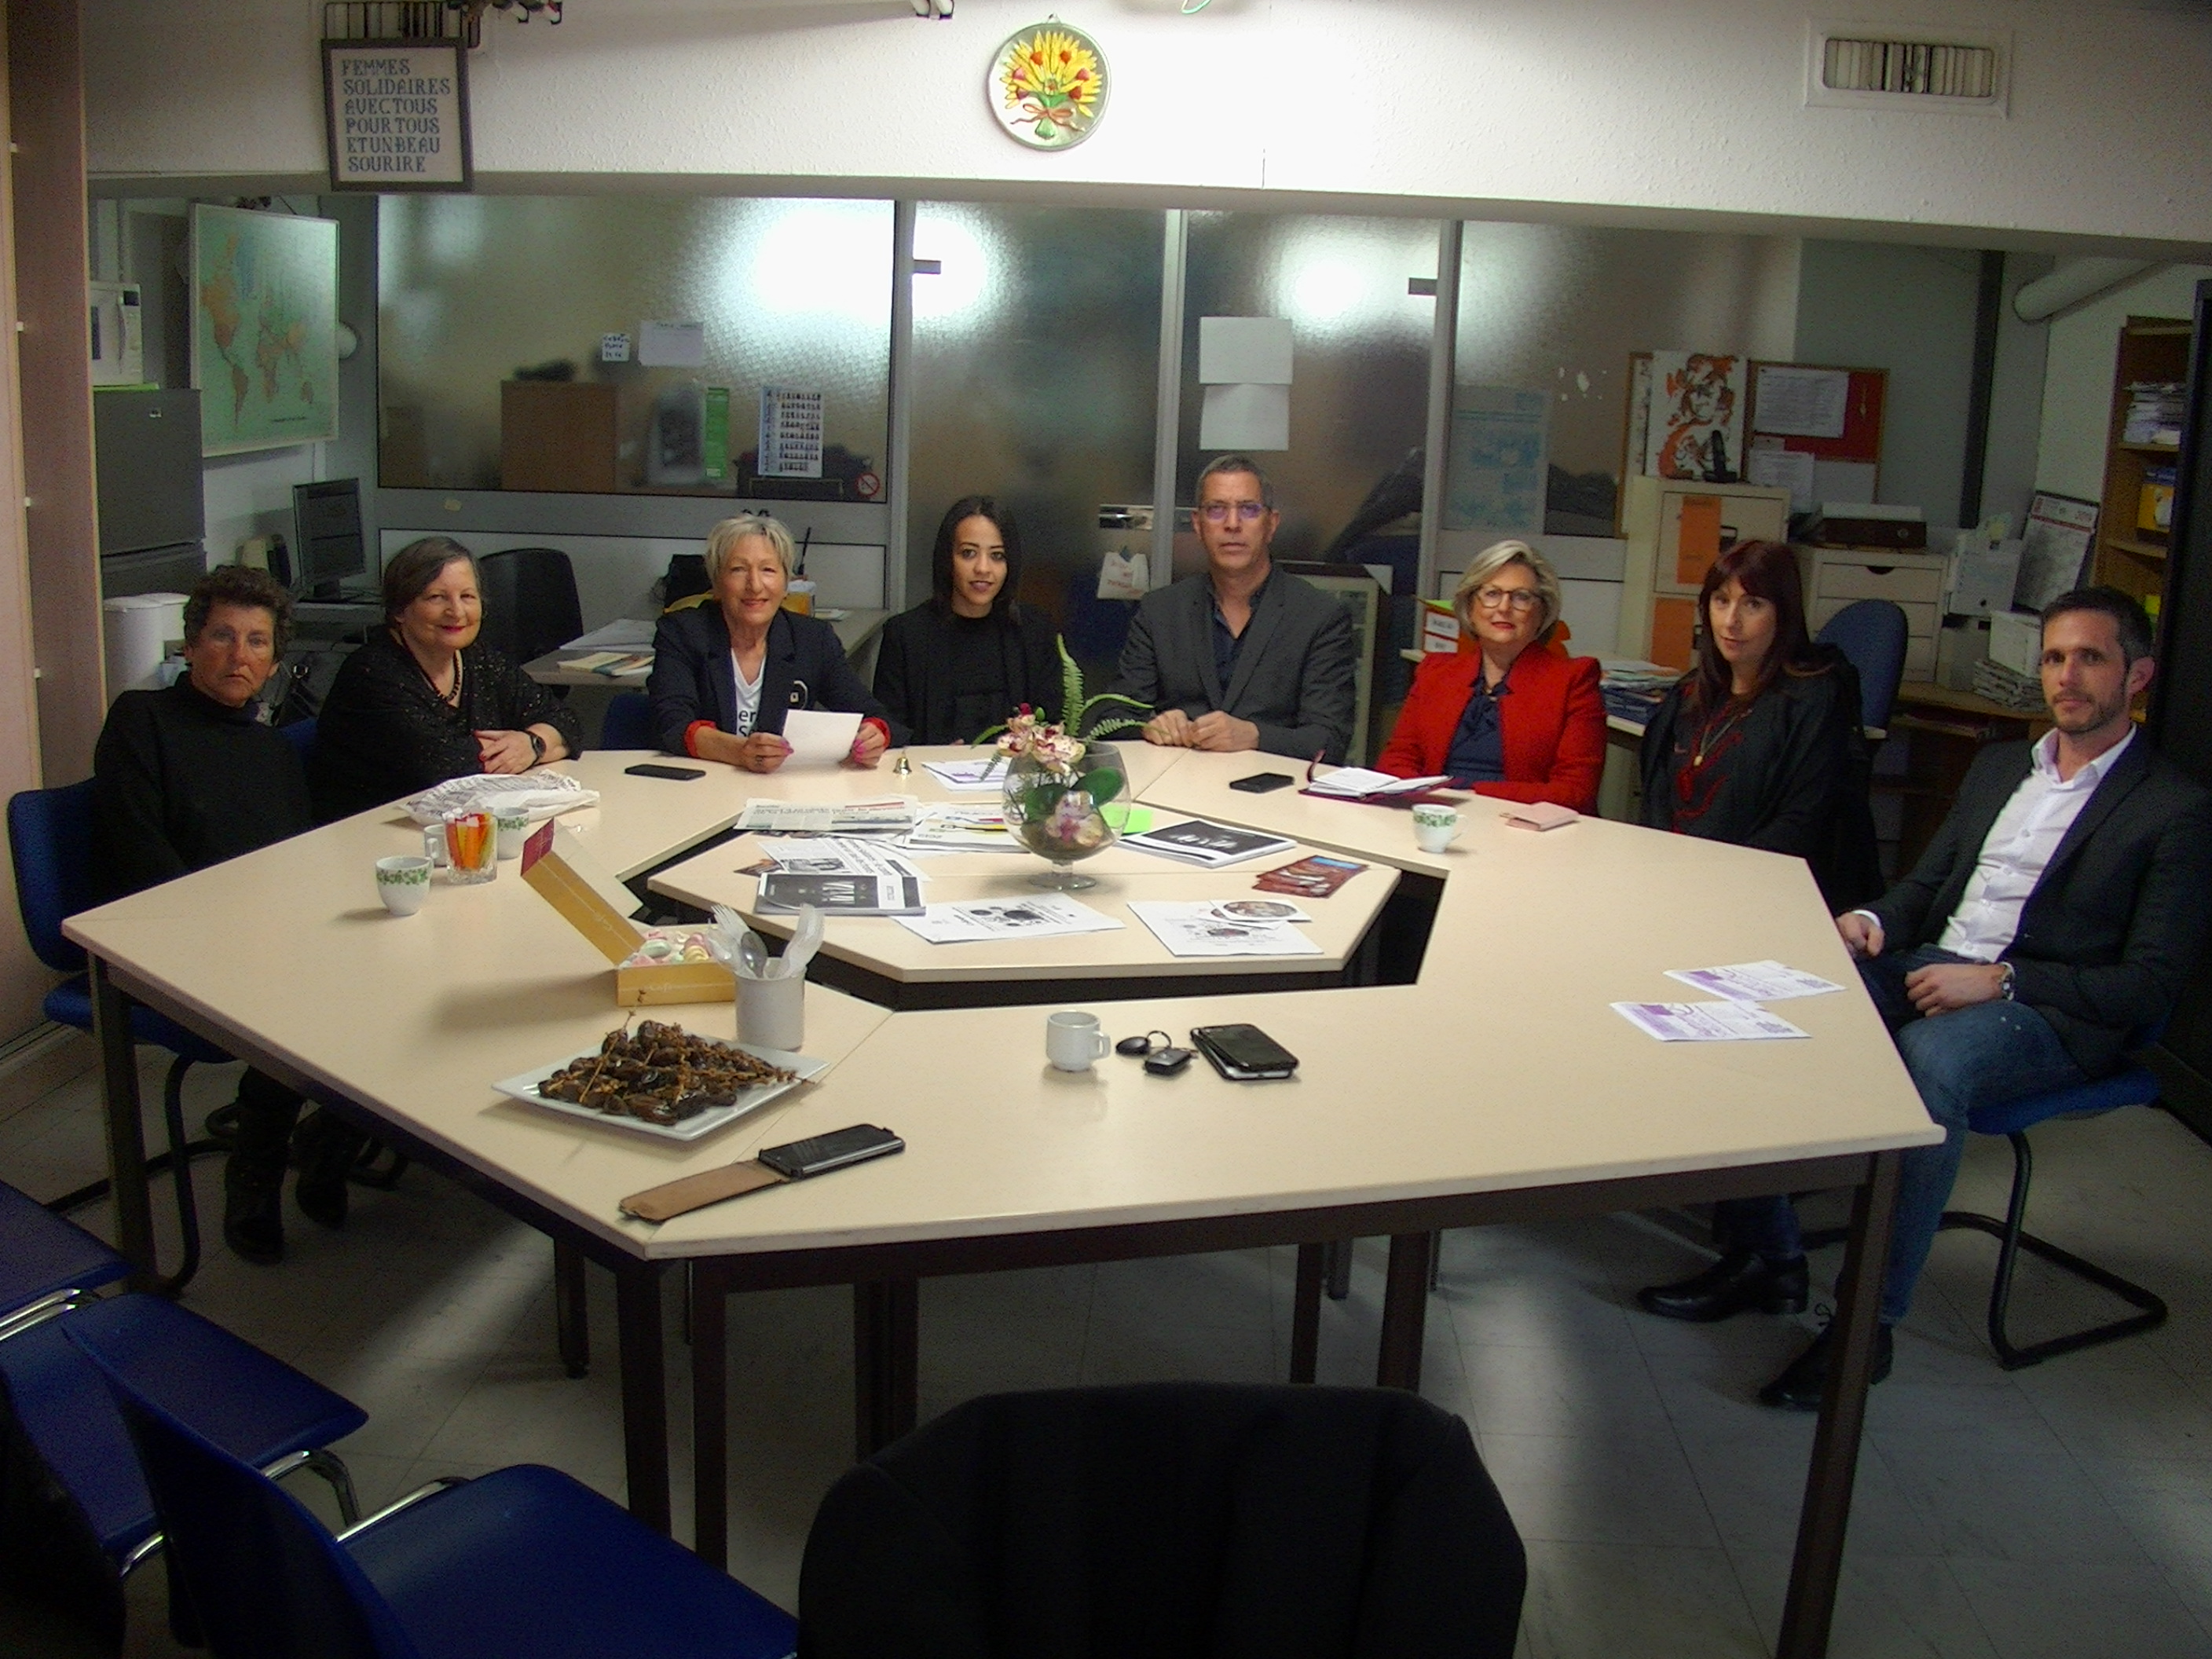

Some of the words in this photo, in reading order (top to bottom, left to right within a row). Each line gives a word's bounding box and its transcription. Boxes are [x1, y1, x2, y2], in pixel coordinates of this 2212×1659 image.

[341, 58, 411, 76] FEMMES
[342, 78, 451, 96] SOLIDAIRES
[344, 97, 391, 115] AVEC
[392, 97, 438, 115] TOUS
[346, 118, 393, 134] POUR
[394, 117, 441, 134] TOUS
[348, 156, 427, 173] SOURIRE
